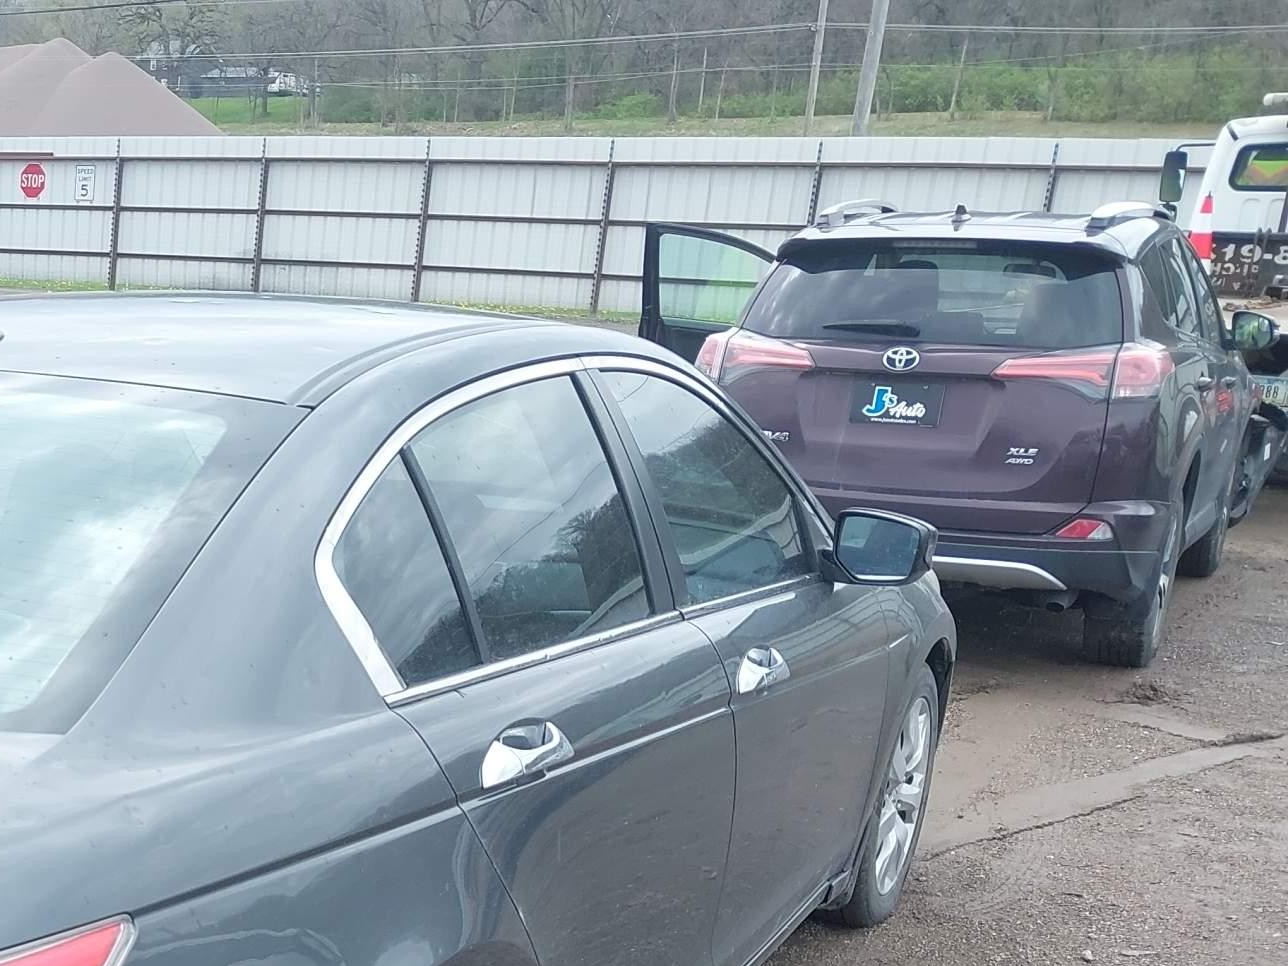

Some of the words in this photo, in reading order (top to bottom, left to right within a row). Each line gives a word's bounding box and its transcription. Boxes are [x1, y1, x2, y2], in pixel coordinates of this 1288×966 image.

[21, 173, 45, 188] STOP
[80, 184, 89, 197] 5
[889, 401, 926, 418] Auto
[1006, 447, 1039, 456] XLE
